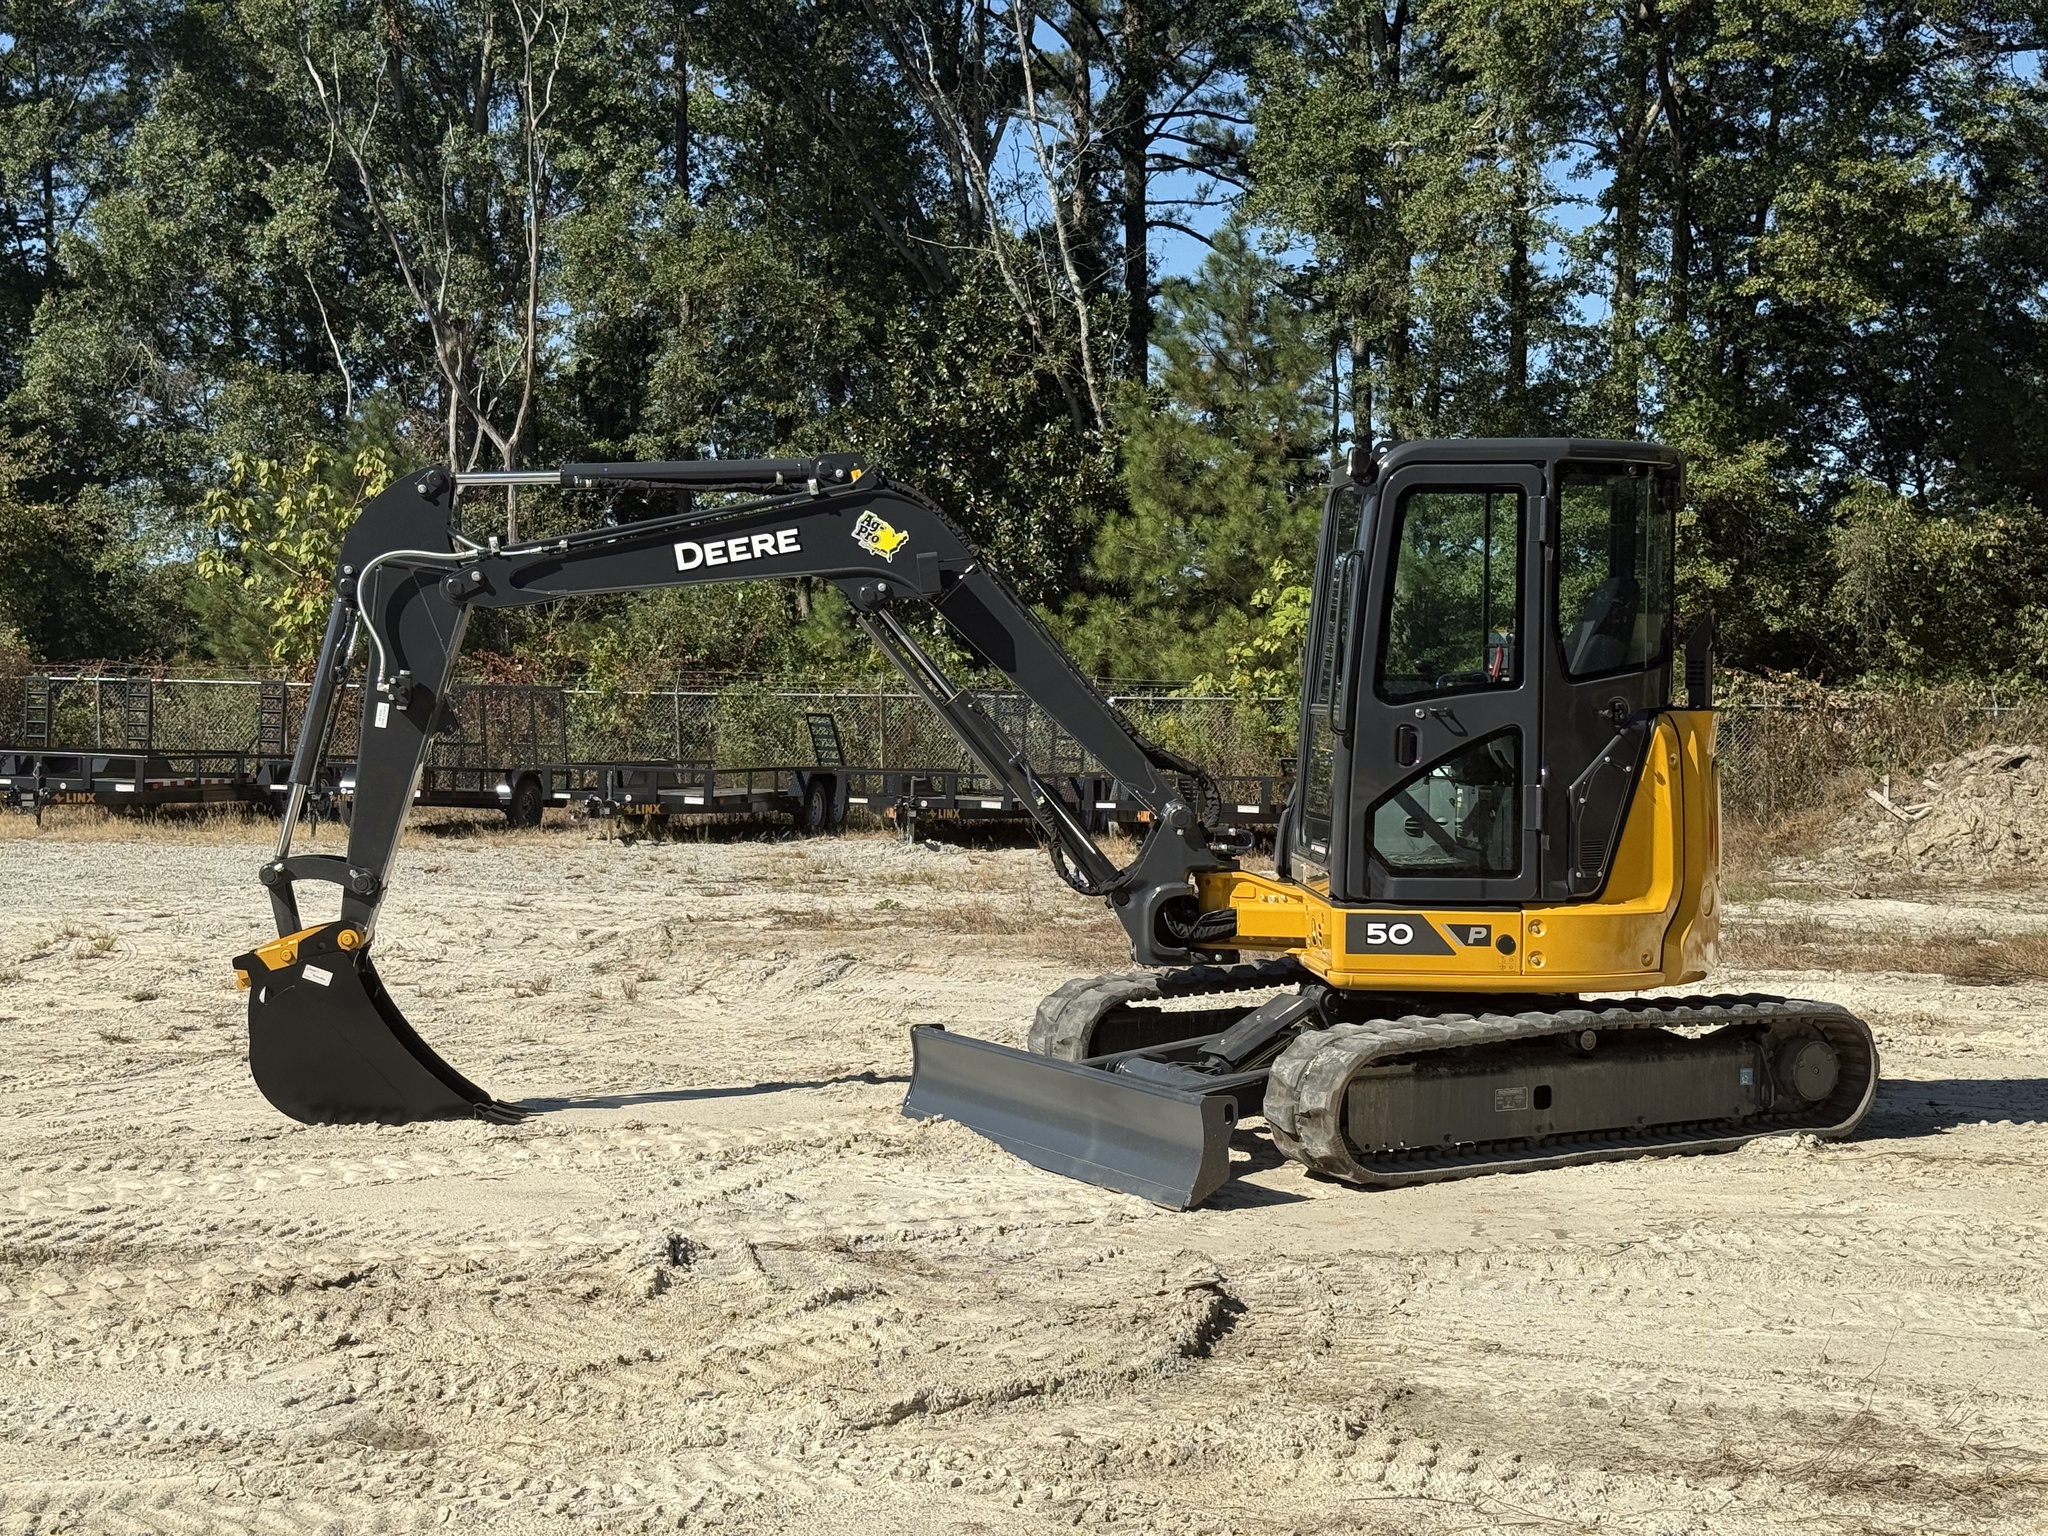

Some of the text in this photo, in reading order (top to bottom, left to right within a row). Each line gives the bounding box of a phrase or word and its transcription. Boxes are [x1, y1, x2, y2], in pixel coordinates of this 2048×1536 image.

[861, 514, 885, 532] Ag-
[856, 525, 880, 543] Pro
[673, 528, 801, 571] DEERE
[65, 792, 97, 804] LINX
[635, 803, 661, 814] LINX
[938, 808, 960, 819] LINX
[1366, 923, 1414, 945] 50
[1467, 927, 1488, 944] P
